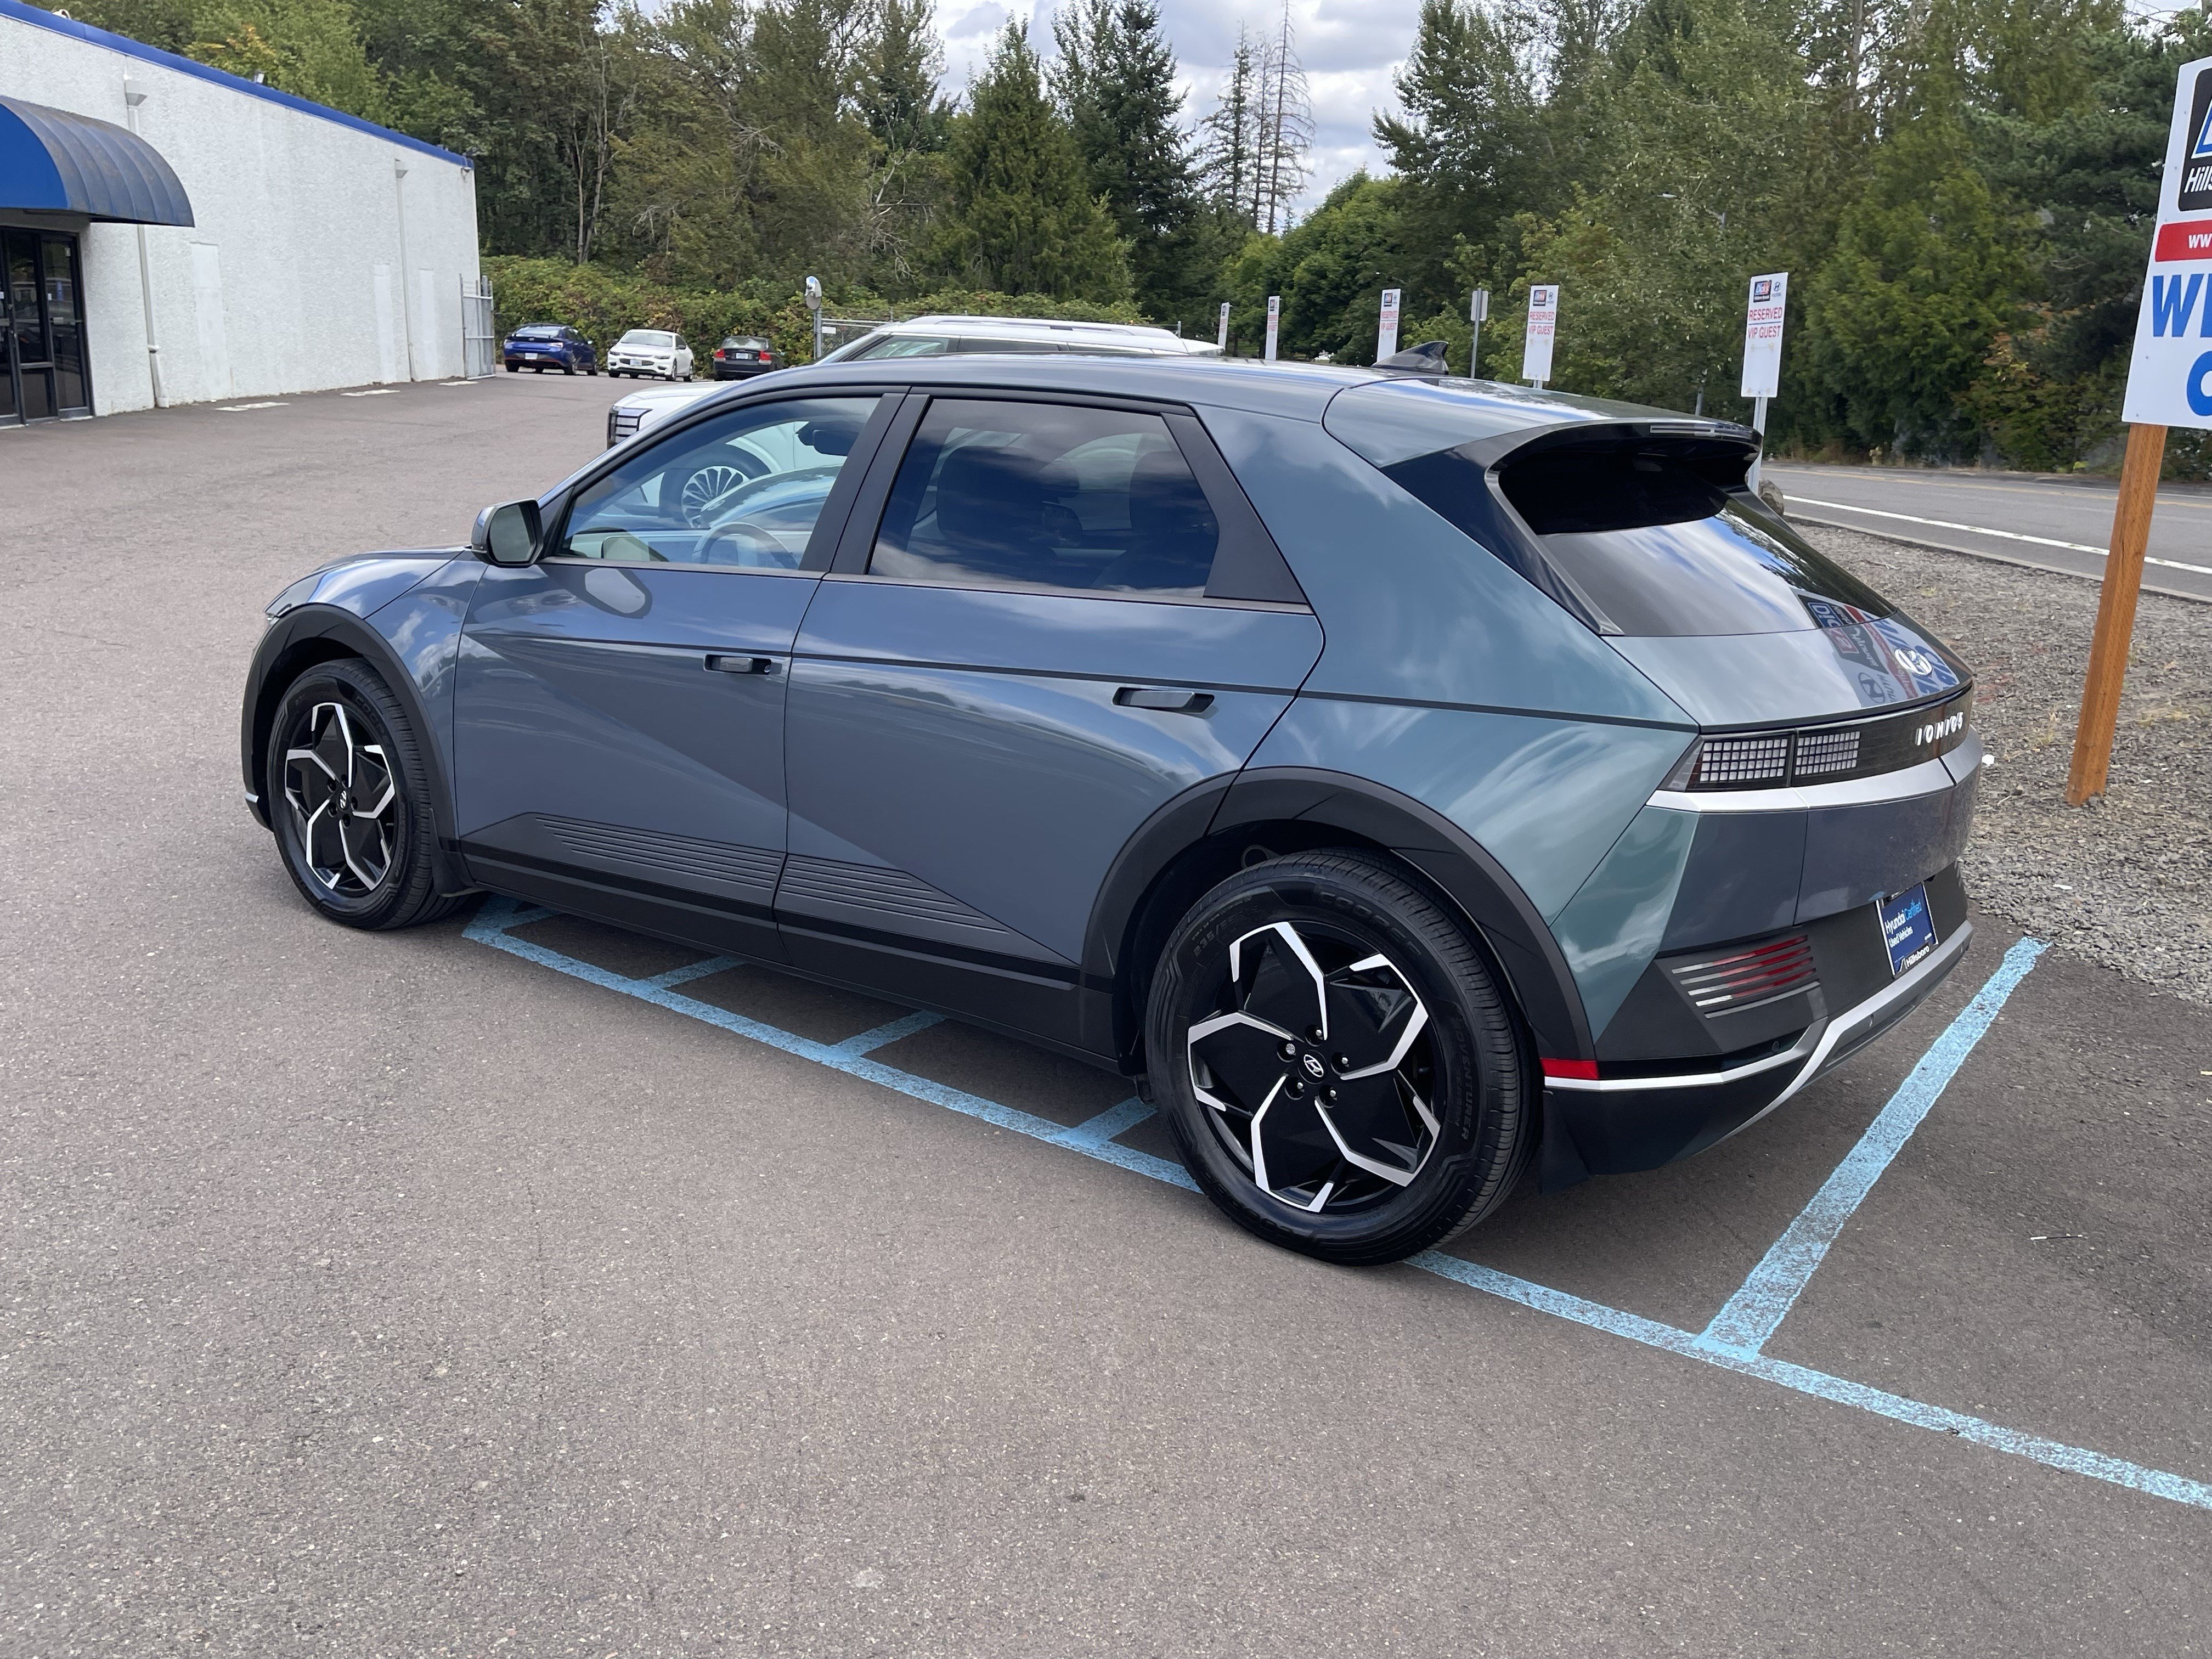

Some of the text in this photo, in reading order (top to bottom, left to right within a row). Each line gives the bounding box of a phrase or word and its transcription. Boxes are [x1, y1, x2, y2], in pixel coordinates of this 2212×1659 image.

[1529, 311, 1555, 321] RESERVED
[1748, 307, 1783, 321] RESERVED
[1748, 325, 1781, 339] VIP GUEST
[1906, 945, 1930, 967] Hillsboro
